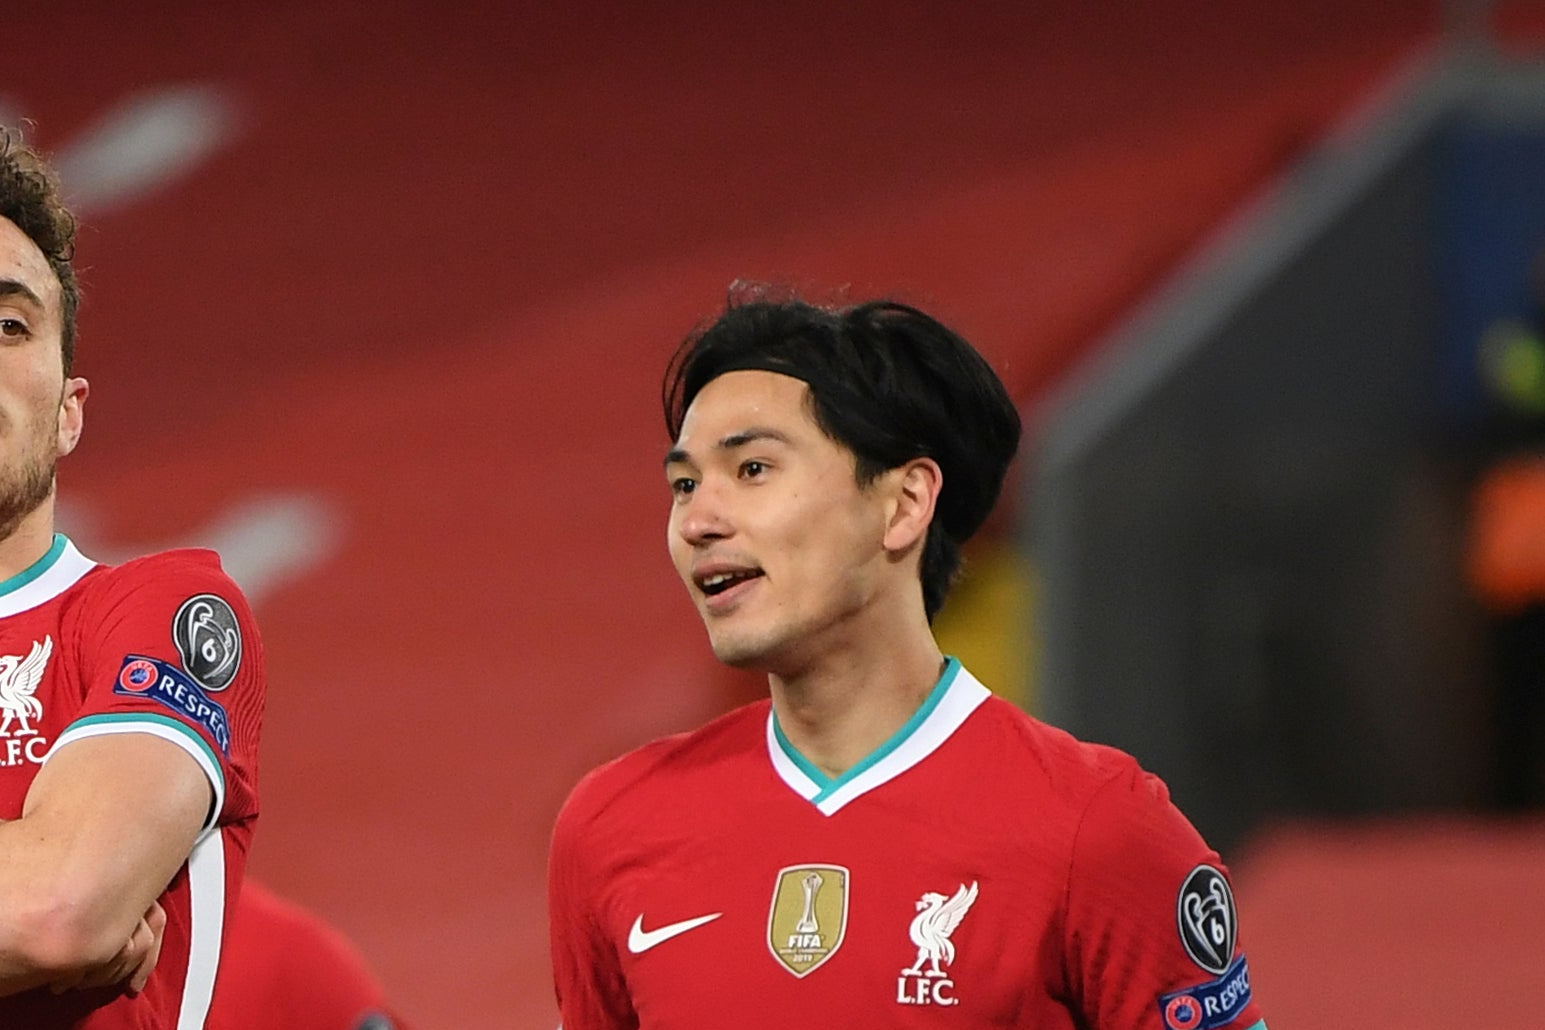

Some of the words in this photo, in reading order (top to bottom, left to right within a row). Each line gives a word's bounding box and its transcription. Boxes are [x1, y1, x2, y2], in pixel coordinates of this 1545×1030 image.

[202, 638, 217, 662] 6
[159, 675, 229, 752] RESPECT
[788, 934, 821, 948] FIFA
[1211, 917, 1225, 945] 6
[897, 977, 959, 1006] L.F.C.
[1204, 964, 1250, 1017] RESPEC
